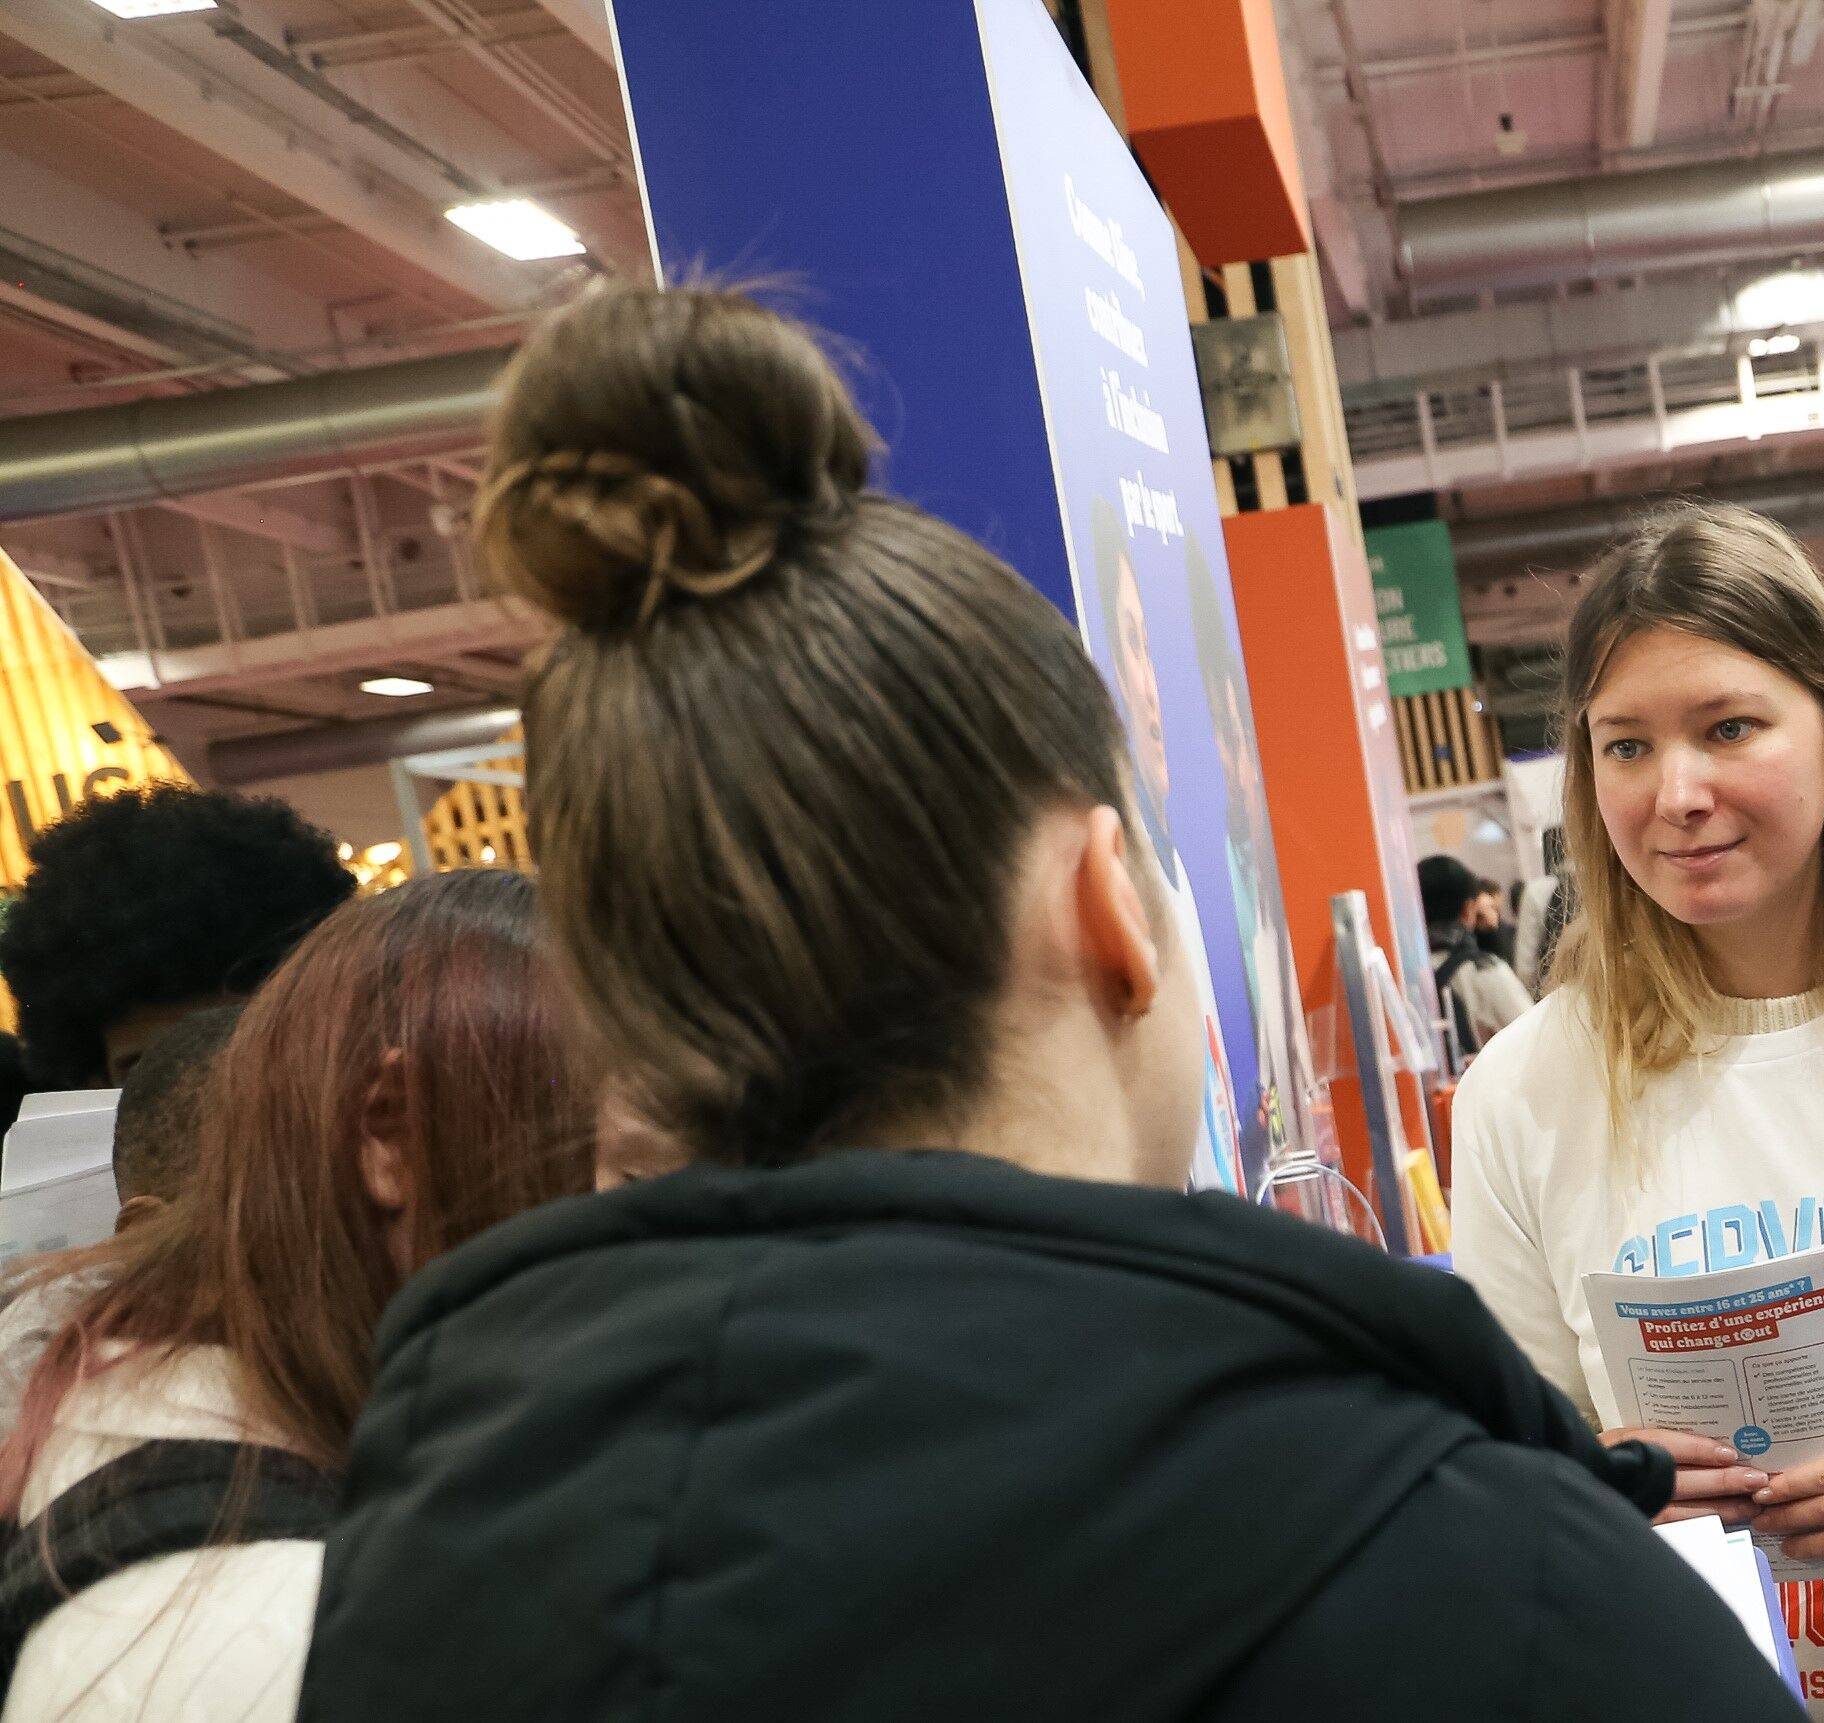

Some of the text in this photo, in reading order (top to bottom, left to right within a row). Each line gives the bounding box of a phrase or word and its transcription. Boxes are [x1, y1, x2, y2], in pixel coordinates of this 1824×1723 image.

[1620, 1304, 1649, 1316] Vous
[1651, 1307, 1678, 1317] avez
[1680, 1303, 1714, 1315] entre
[1716, 1299, 1731, 1311] 16
[1733, 1297, 1747, 1308] et
[1749, 1291, 1765, 1304] 25
[1644, 1321, 1707, 1334] Profitez
[1709, 1314, 1754, 1330] d'une
[1649, 1337, 1675, 1351] qui
[1677, 1333, 1731, 1349] change
